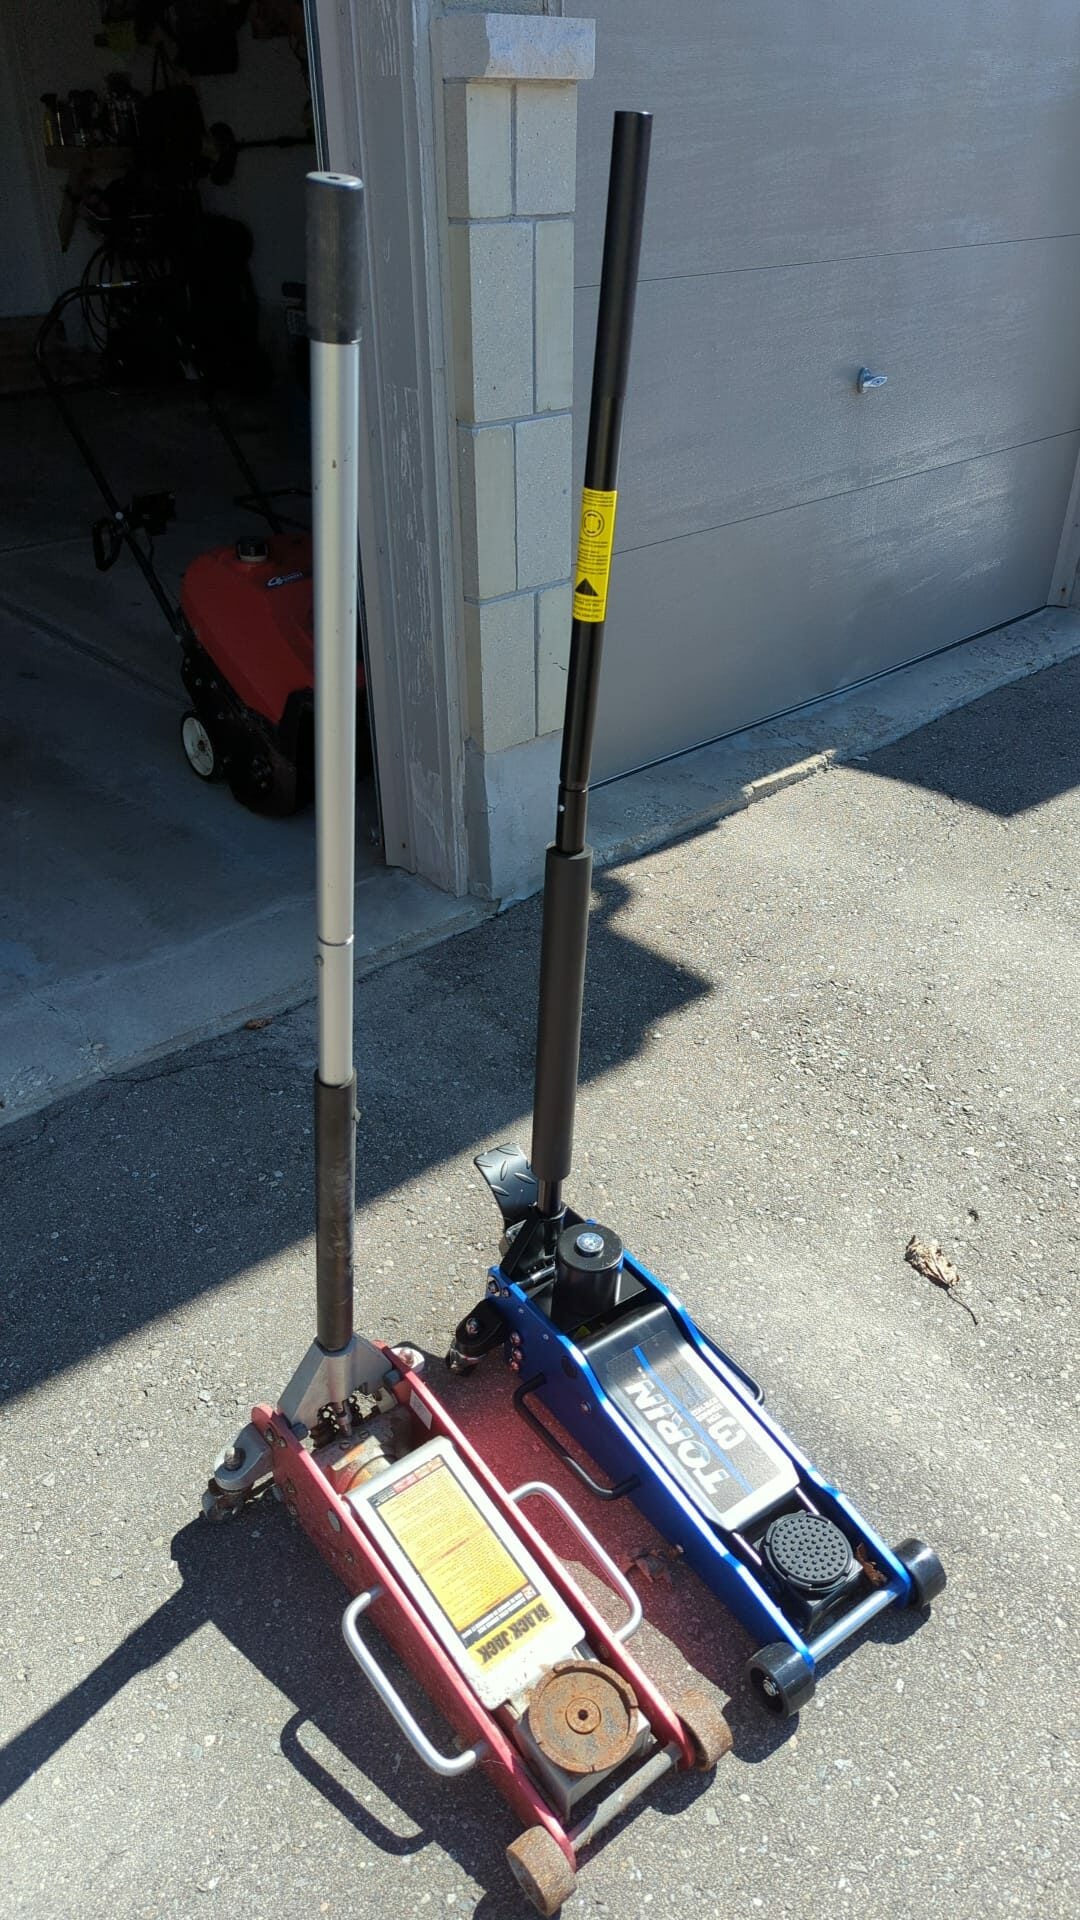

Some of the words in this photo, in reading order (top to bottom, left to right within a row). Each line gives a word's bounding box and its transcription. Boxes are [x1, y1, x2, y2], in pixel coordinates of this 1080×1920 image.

[626, 1380, 729, 1494] TORIN
[708, 1416, 746, 1450] 3
[508, 1603, 549, 1640] BLACK
[476, 1631, 510, 1663] JACK
